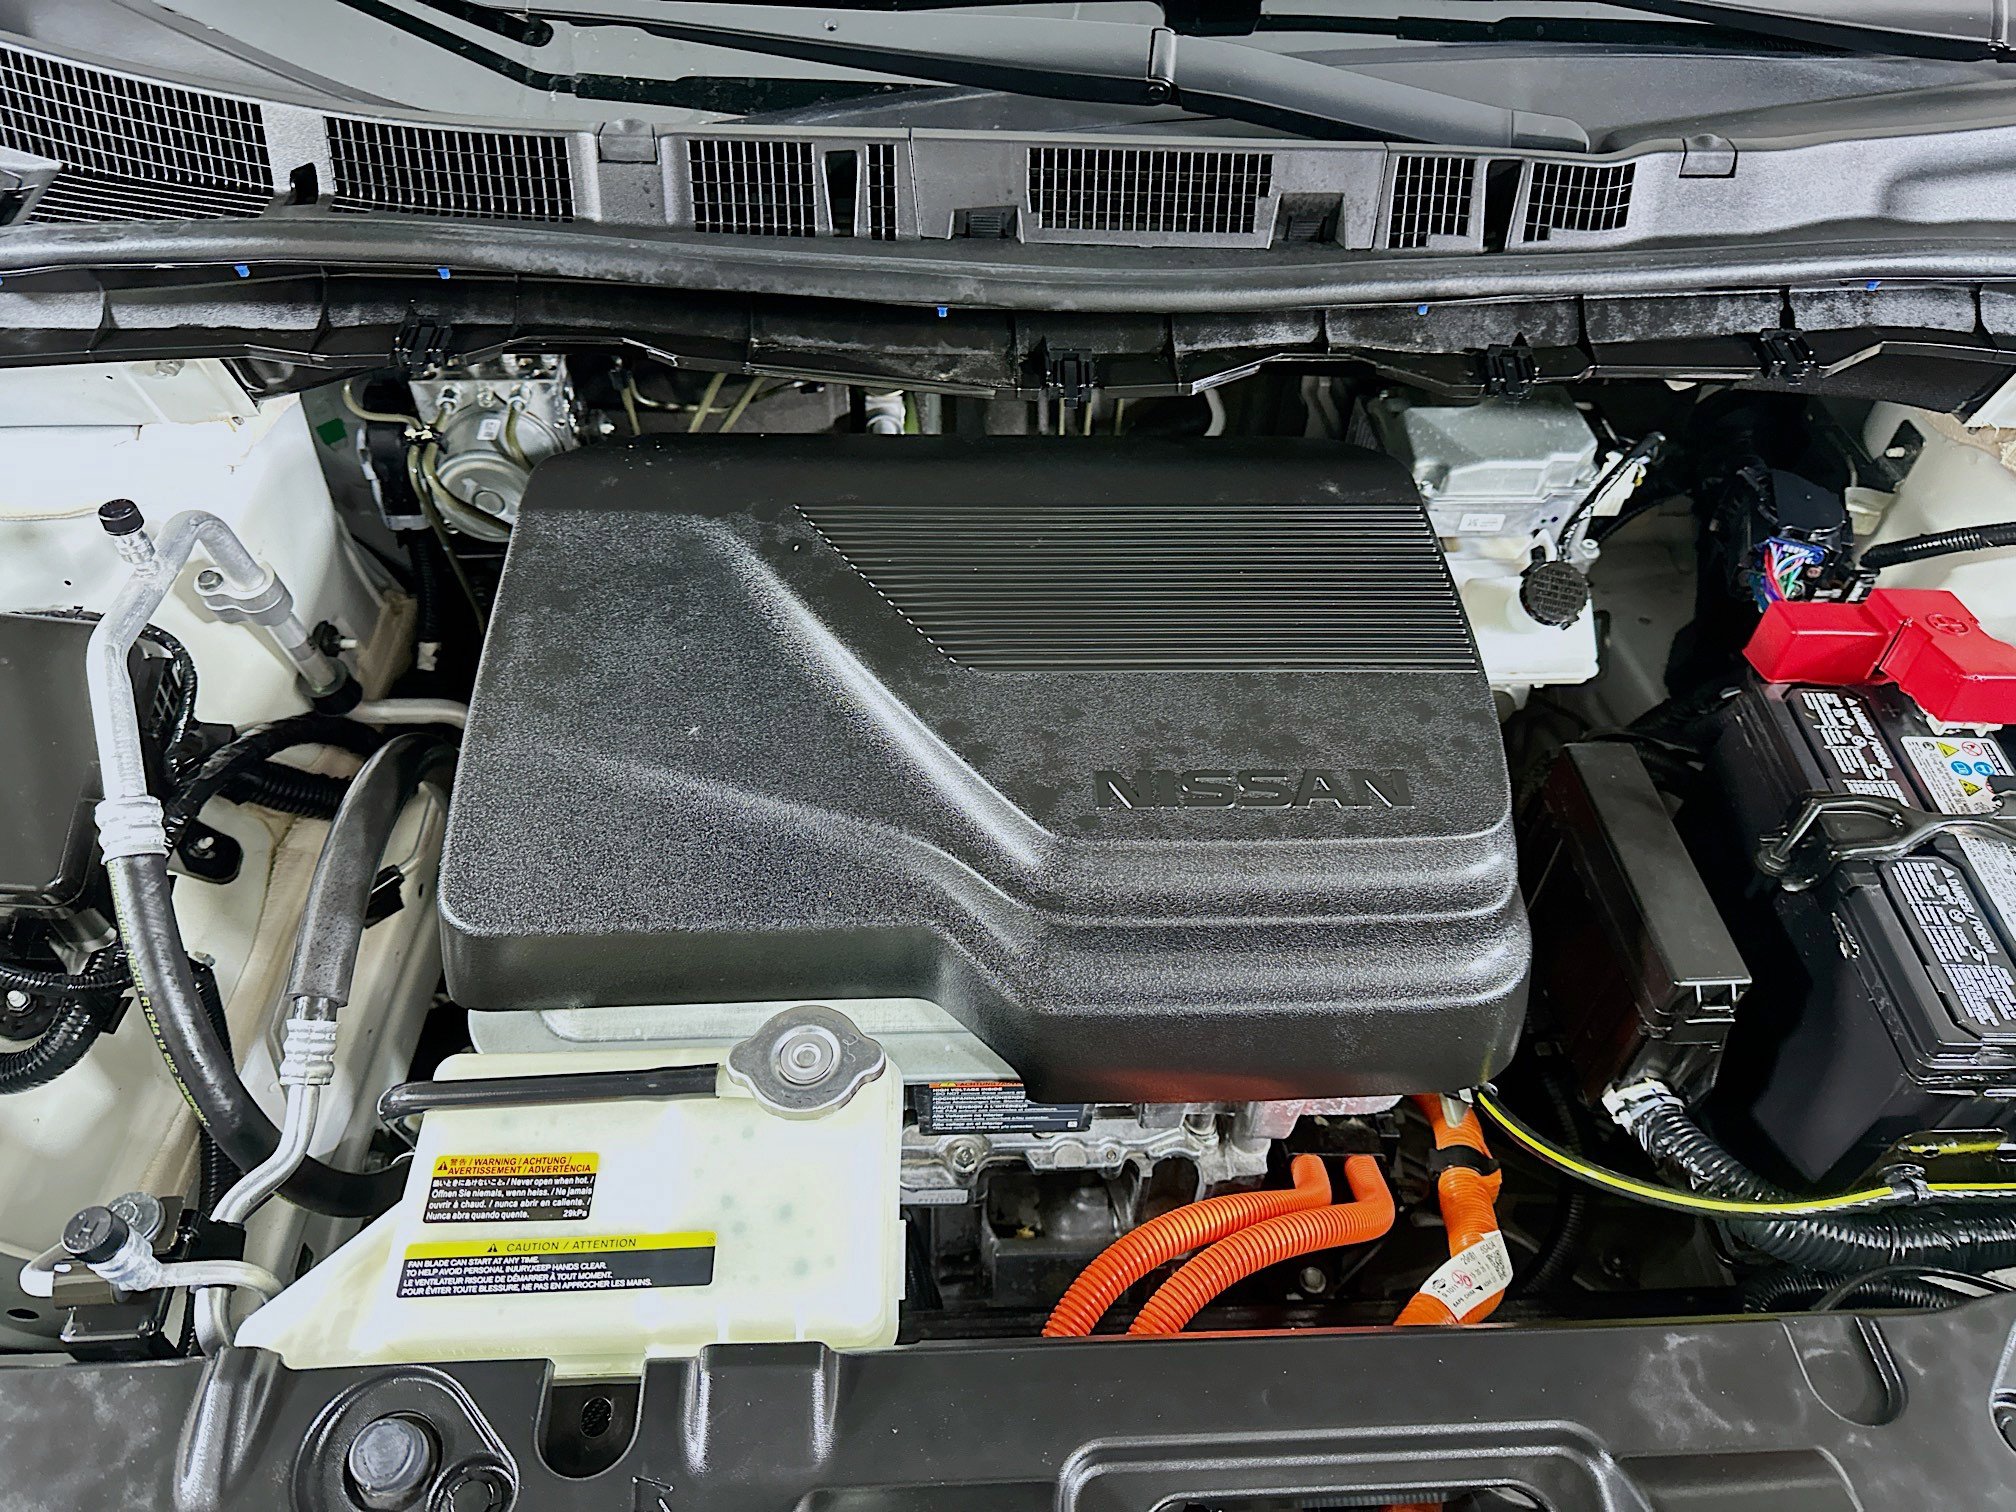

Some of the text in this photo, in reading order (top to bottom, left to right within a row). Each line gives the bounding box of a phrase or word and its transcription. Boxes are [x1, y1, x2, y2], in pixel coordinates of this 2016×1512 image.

[1095, 769, 1415, 809] NISSAN
[141, 996, 161, 1036] R134a
[163, 1052, 178, 1074] SUC
[523, 1157, 566, 1165] ACHTUNG
[448, 1166, 522, 1175] AVERTISSEMENT
[511, 1178, 534, 1186] Never
[534, 1179, 553, 1187] open
[554, 1177, 574, 1185] when
[575, 1176, 589, 1184] hot.
[458, 1189, 471, 1197] Sie
[472, 1189, 504, 1198] niemals,
[566, 1187, 592, 1197] jamais
[429, 1201, 452, 1209] ouvrir
[461, 1200, 486, 1208] chaud.
[520, 1199, 539, 1207] abrir
[552, 1198, 585, 1206] caliente.
[426, 1211, 529, 1220] Nunca abra quando quente.
[563, 1209, 587, 1217] 29kPa
[507, 1242, 559, 1252] CAUTION
[572, 1238, 636, 1249] ATTENTION
[408, 1260, 423, 1268] FAN
[468, 1258, 492, 1266] START
[521, 1256, 540, 1264] TIME.
[439, 1268, 462, 1276] AVOID
[464, 1266, 504, 1274] PERSONAL
[552, 1263, 579, 1271] HANDS
[415, 1278, 464, 1286] VENTILATEUR
[465, 1276, 494, 1284] RISQUE
[507, 1274, 550, 1282] DÉMARRER
[550, 1272, 556, 1281] À
[578, 1271, 613, 1280] MOMENT.
[402, 1288, 424, 1296] POUR
[425, 1285, 452, 1295] ÉVITER
[478, 1284, 520, 1293] BLESSURE,
[562, 1280, 611, 1289] APPROCHER
[626, 1278, 652, 1286] MAINS.
